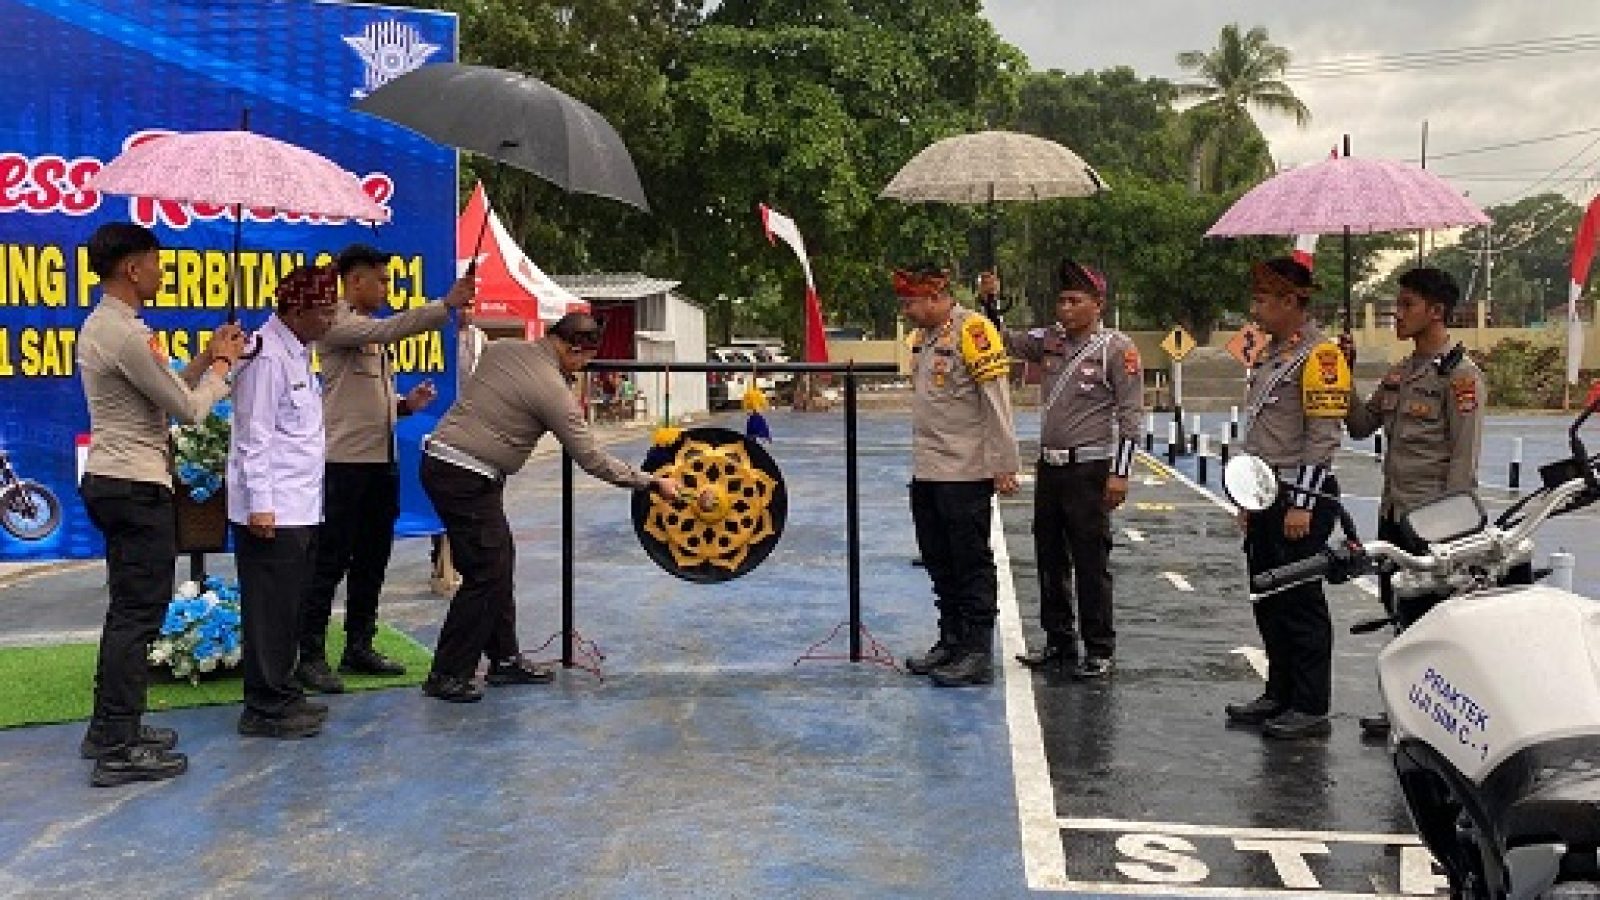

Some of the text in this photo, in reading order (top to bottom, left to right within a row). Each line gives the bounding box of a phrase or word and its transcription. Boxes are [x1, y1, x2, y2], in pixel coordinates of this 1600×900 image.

[387, 255, 426, 309] C1
[1408, 684, 1431, 713] UJI
[1431, 702, 1457, 735] SIM
[1424, 668, 1488, 731] PRAKTEK
